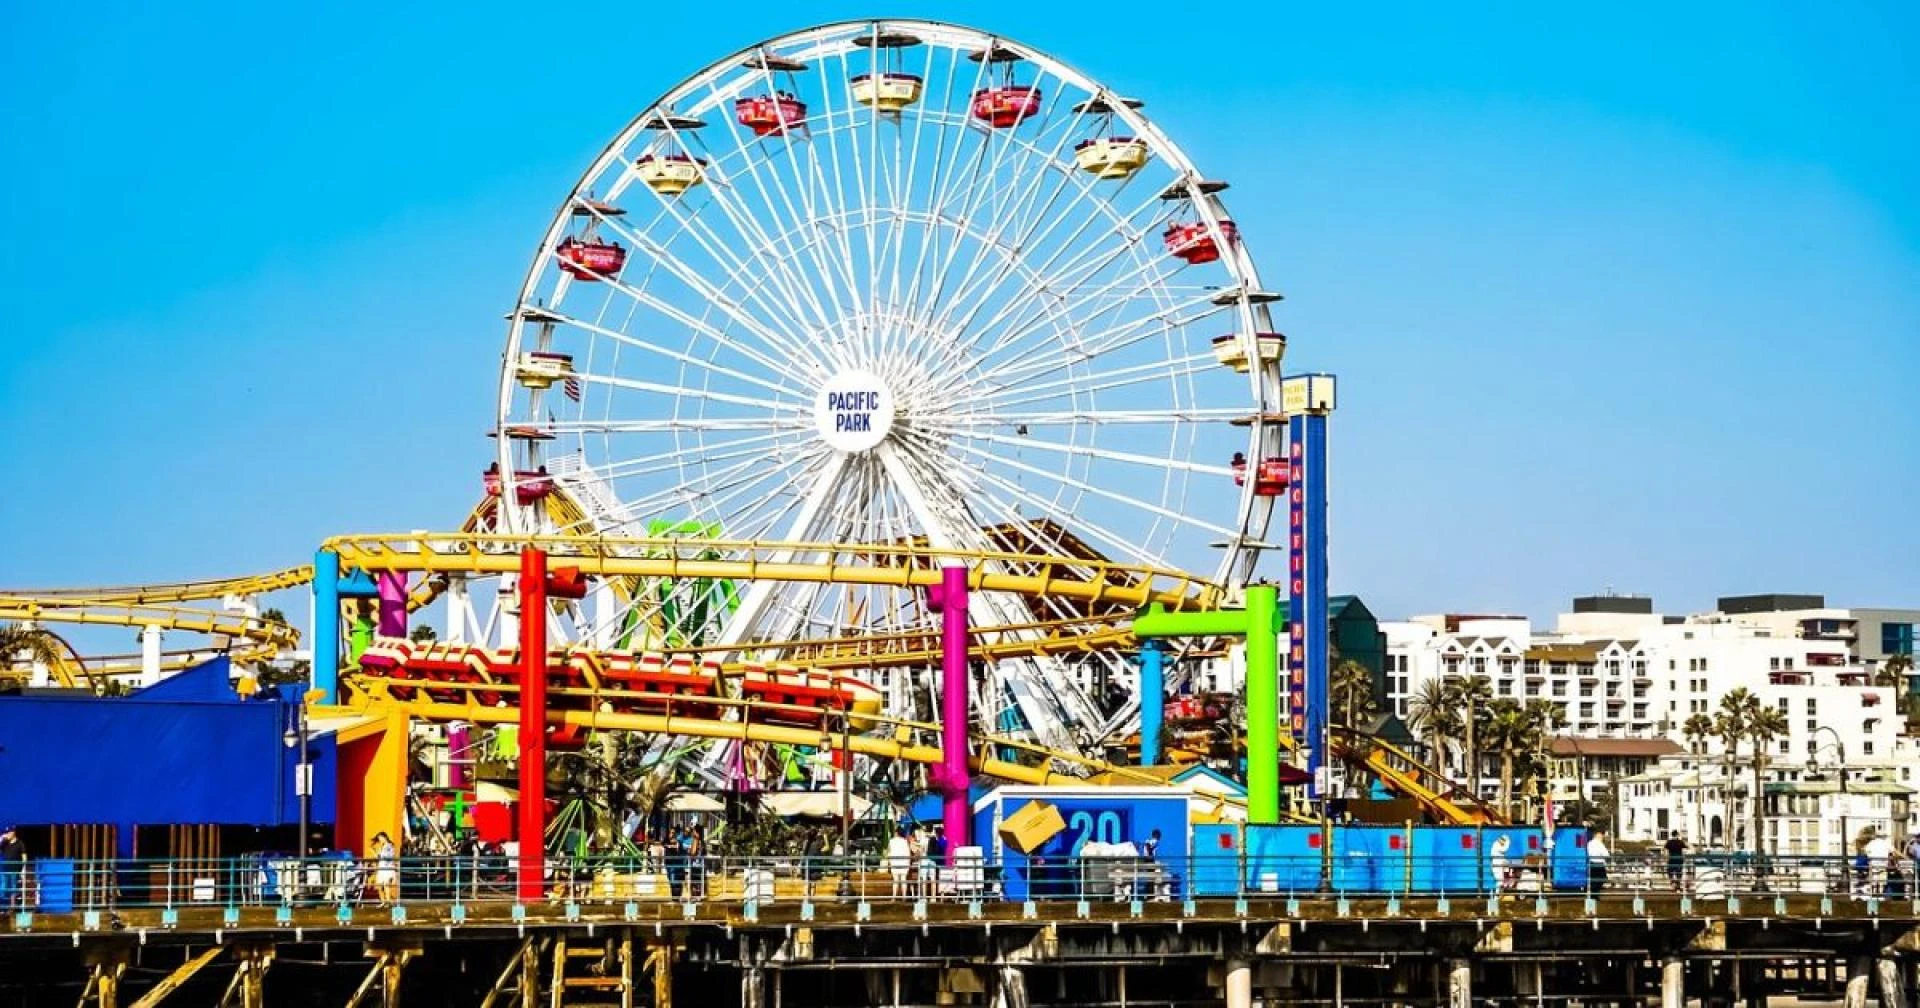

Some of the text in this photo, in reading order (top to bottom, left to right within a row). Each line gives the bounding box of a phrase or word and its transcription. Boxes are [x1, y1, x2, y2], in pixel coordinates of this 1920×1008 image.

[828, 391, 880, 411] PACIFIC
[836, 413, 871, 433] PARK
[1292, 442, 1303, 594] PACIFIC
[1070, 810, 1121, 857] 20
